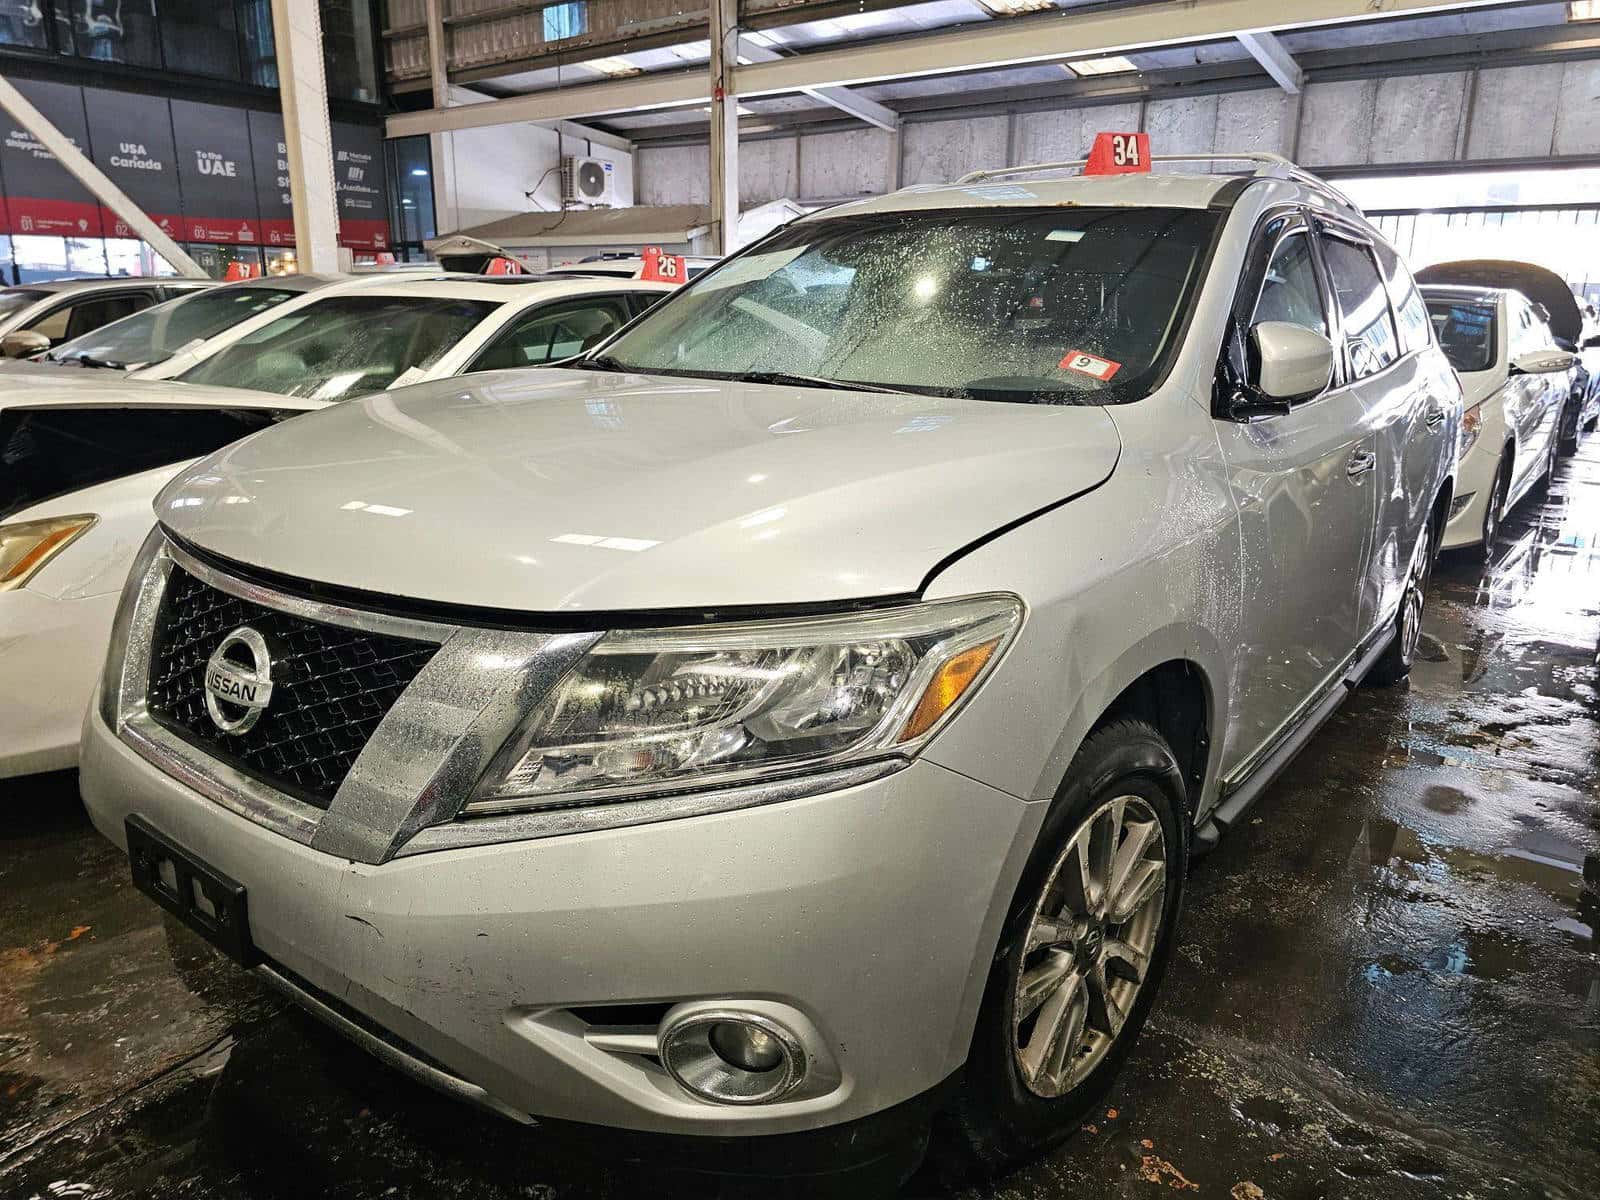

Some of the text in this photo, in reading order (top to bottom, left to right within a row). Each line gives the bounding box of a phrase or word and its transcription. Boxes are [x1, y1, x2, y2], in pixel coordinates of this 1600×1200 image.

[120, 142, 147, 155] USA
[195, 150, 223, 161] To the
[1113, 135, 1139, 166] 34
[110, 156, 162, 170] Canada
[198, 159, 237, 177] UAE
[115, 223, 128, 237] 02
[194, 227, 206, 240] 03
[270, 231, 281, 243] 04
[658, 256, 677, 277] 26
[206, 669, 257, 702] NISSAN
